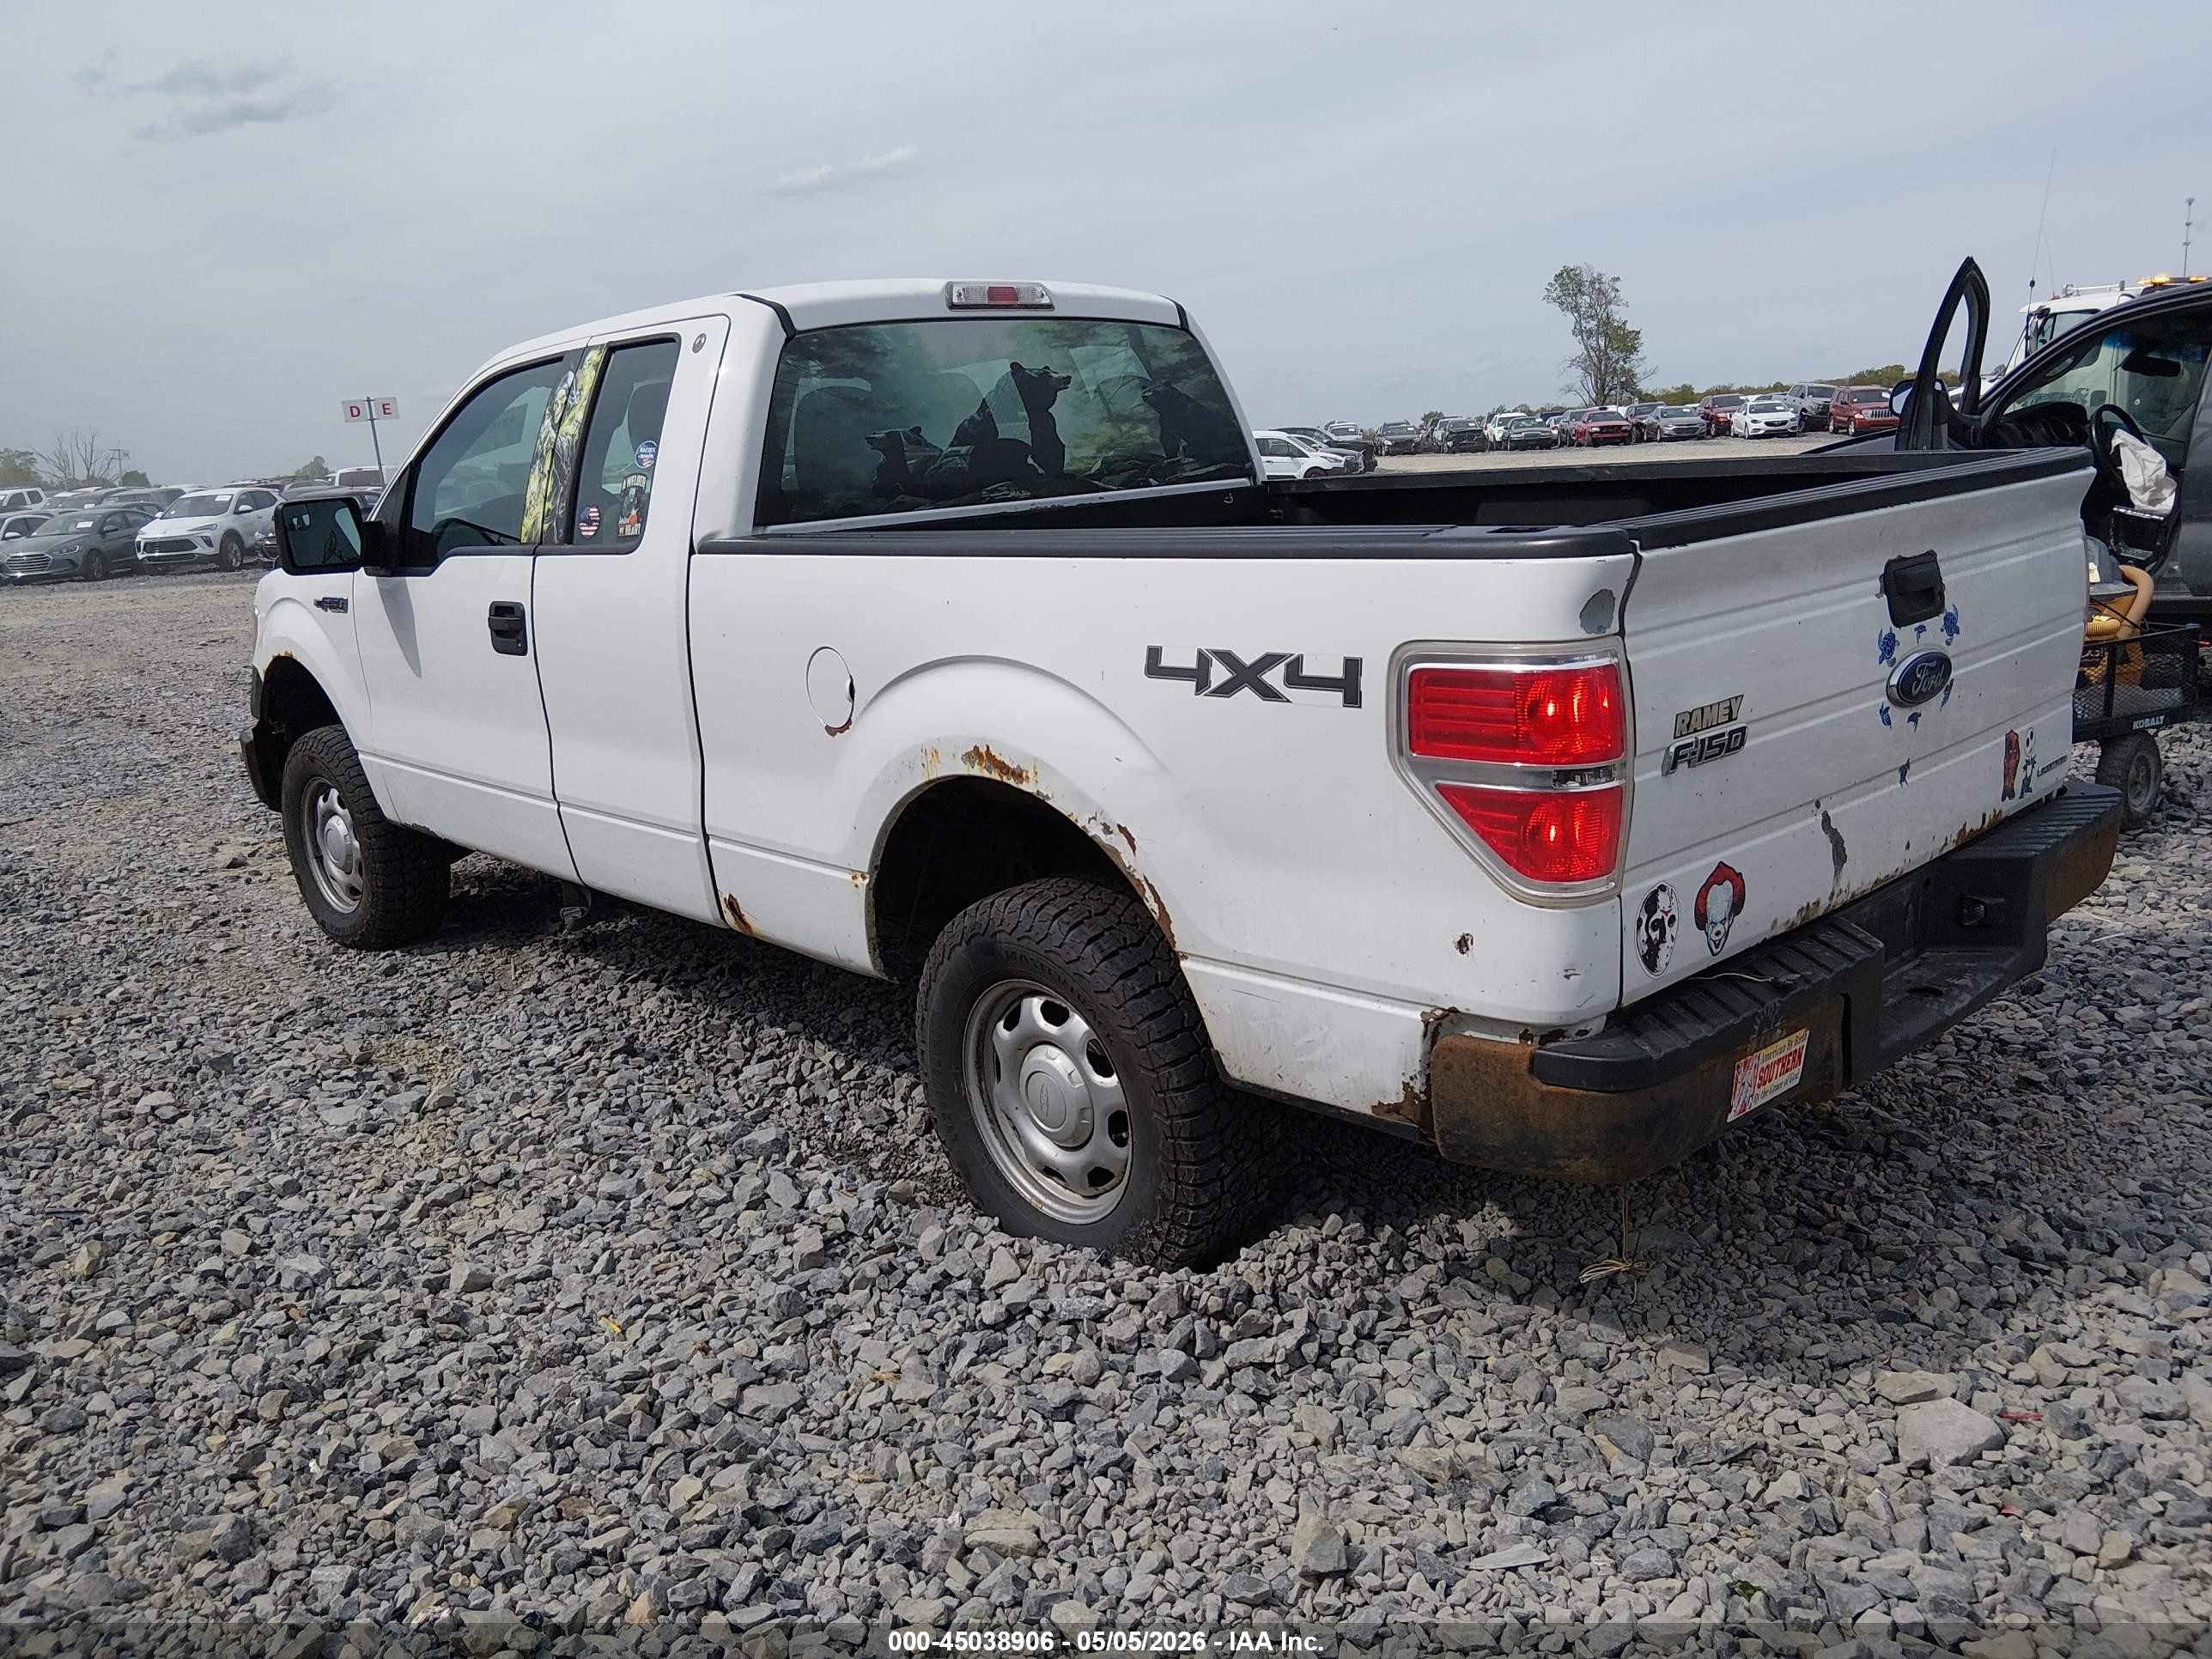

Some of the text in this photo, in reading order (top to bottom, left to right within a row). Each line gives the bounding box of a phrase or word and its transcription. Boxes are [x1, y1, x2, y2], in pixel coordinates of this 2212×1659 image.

[349, 405, 361, 418] D
[382, 403, 392, 415] E
[626, 474, 647, 488] WELDER
[625, 523, 641, 536] HEART
[1911, 660, 1945, 696] Ford
[1673, 694, 1744, 739] RAMEY
[2132, 715, 2165, 730] KOBALT
[1662, 722, 1748, 776] F-150
[1761, 1042, 1786, 1064] American
[1757, 1044, 1805, 1089] SOUTHERN
